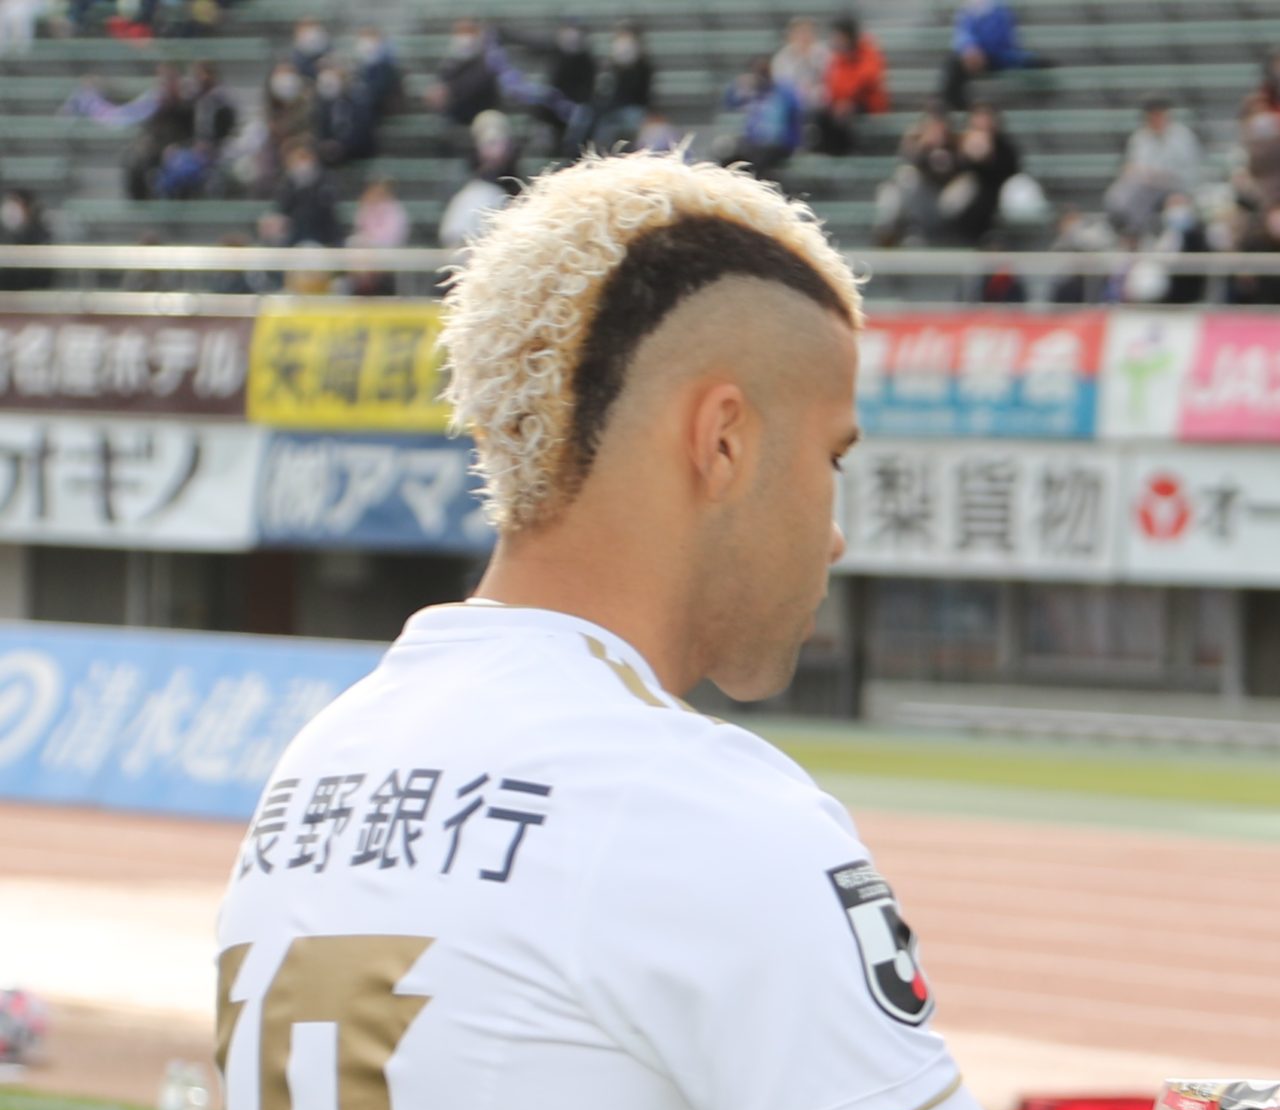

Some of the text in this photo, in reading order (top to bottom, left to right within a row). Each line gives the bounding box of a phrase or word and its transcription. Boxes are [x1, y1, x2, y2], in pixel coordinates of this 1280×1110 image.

[0, 322, 243, 396] 名屋ホテル
[238, 767, 553, 884] 長野銀行
